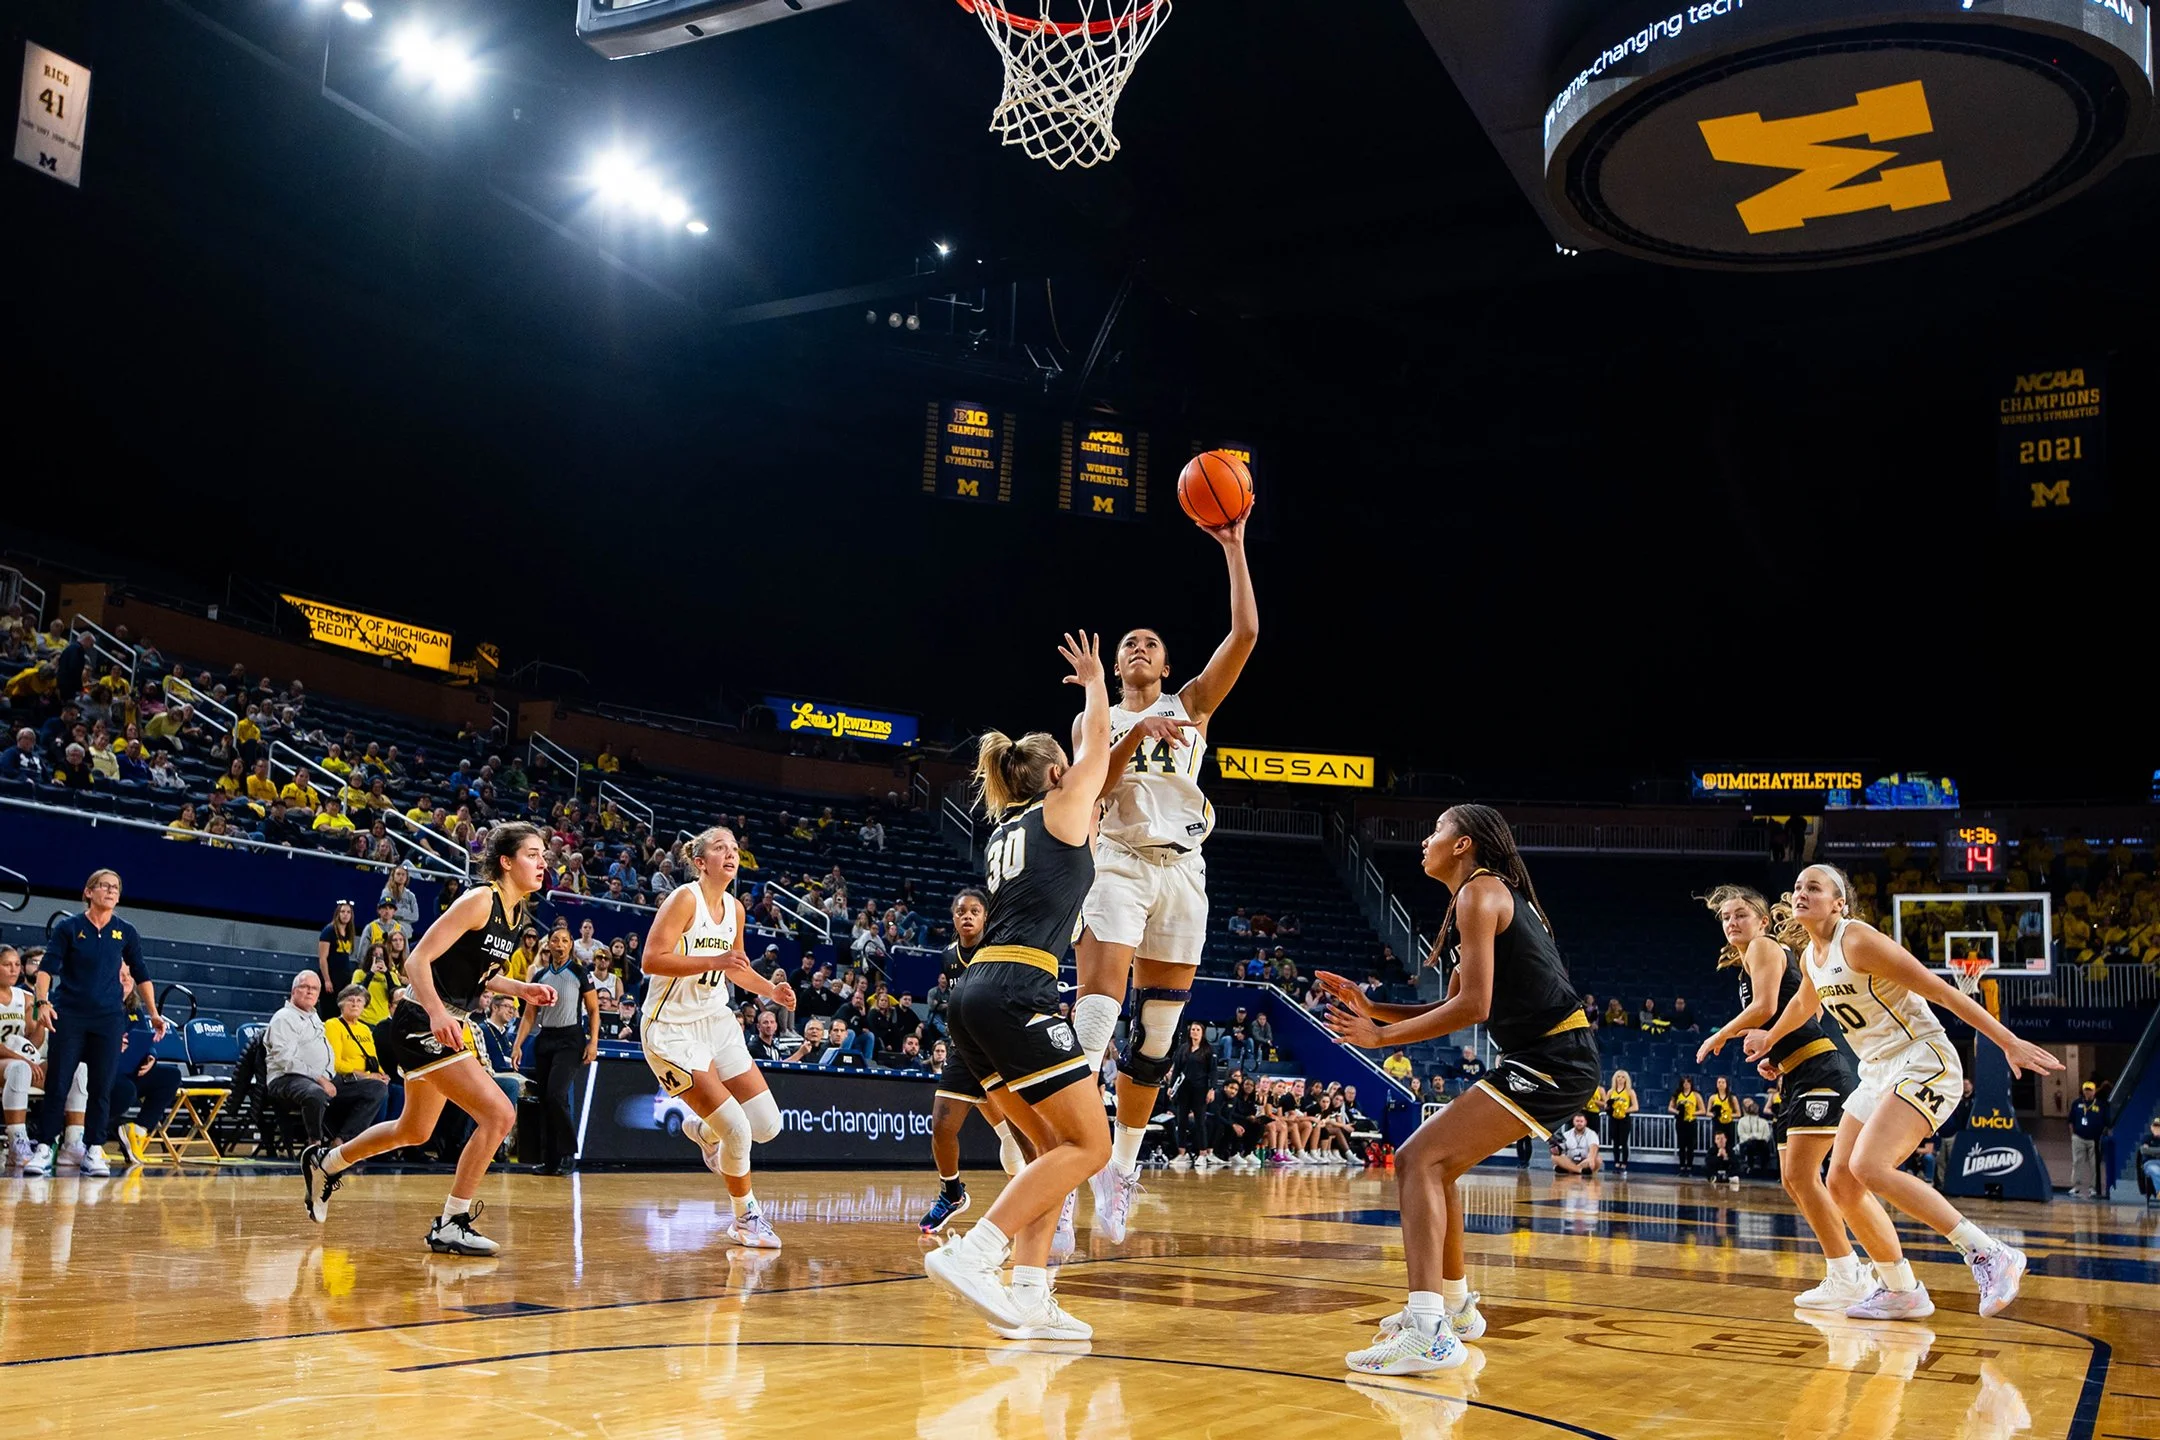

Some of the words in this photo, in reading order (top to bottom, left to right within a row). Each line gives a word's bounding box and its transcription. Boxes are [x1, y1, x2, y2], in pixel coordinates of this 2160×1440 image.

[1556, 13, 1683, 113] Game-changing
[43, 64, 70, 86] RICE
[39, 88, 65, 119] 41
[38, 151, 58, 171] M
[1698, 79, 1952, 235] M
[2014, 367, 2085, 393] NCAA
[2000, 388, 2100, 413] CHAMPIONS
[2001, 411, 2042, 425] WOMEN'S
[2043, 405, 2099, 422] GYMNASTICS
[947, 423, 994, 438] CHAMPIONS
[1088, 430, 1123, 444] NCAA
[951, 445, 989, 459] WOMEN'S
[1080, 441, 1130, 456] SEMI-FINALS
[1218, 447, 1250, 463] AA
[2019, 436, 2083, 464] 2021
[944, 455, 994, 470] GYMNASTICS
[1086, 462, 1123, 476] WOMEN'S
[957, 478, 979, 497] M
[1080, 472, 1129, 487] GYMNASTICS
[2030, 480, 2071, 508] M
[1093, 495, 1114, 514] M
[290, 599, 363, 627] IVERSITY
[366, 618, 384, 633] OF
[386, 626, 449, 649] MICHIGAN
[376, 635, 418, 655] UNION
[832, 712, 892, 738] JEWELERS
[1128, 737, 1177, 773] 44
[1225, 754, 1364, 780] NISSAN
[1702, 772, 1862, 790] @UMICHATHLETICS
[1959, 826, 1998, 845] 4:36
[987, 826, 1026, 895] 30
[1966, 846, 1994, 873] 14
[483, 934, 515, 953] PURD
[694, 937, 733, 951] MICHIG
[204, 1023, 225, 1034] Ruoff
[2010, 1018, 2050, 1028] FAMILY
[2067, 1018, 2113, 1029] TUNNEL
[658, 1070, 681, 1091] M
[1914, 1085, 1945, 1114] M
[780, 1105, 905, 1141] me-changing
[909, 1110, 934, 1135] tec
[1971, 1116, 2014, 1129] UMCU
[1962, 1152, 2018, 1177] LIBMAN
